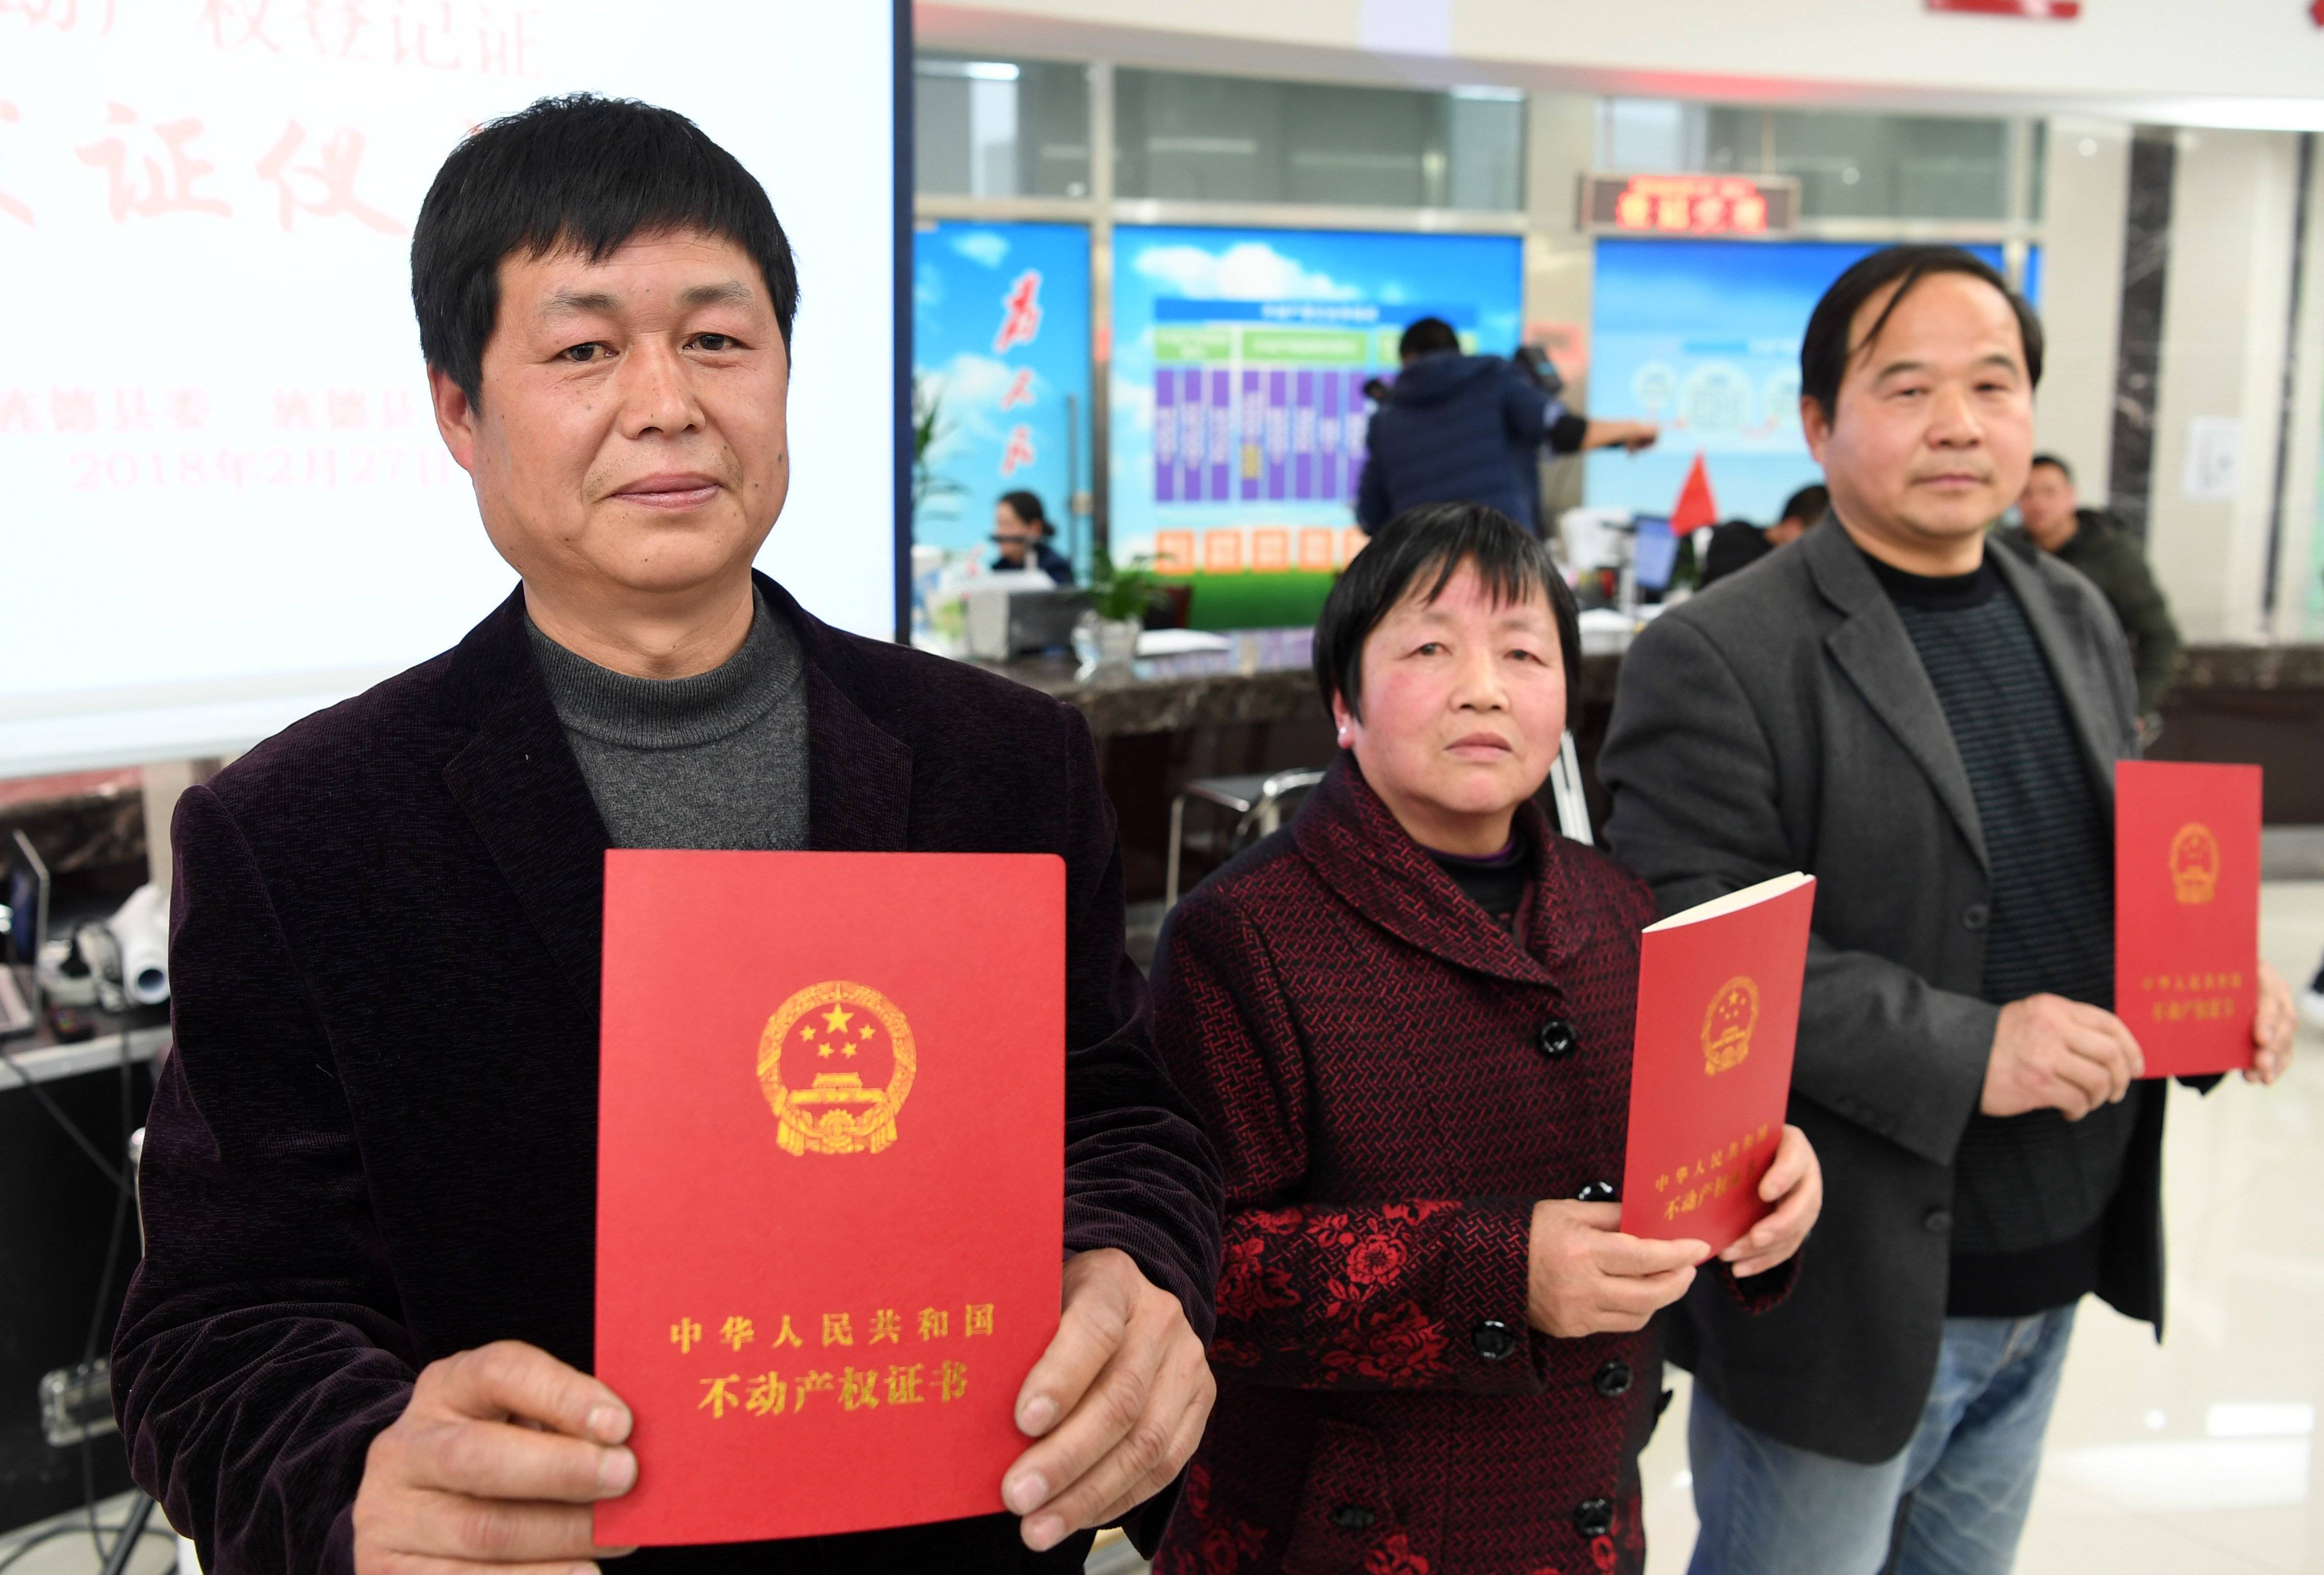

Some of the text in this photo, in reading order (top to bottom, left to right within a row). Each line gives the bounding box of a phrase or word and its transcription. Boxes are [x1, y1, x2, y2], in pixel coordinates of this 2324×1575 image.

[0, 100, 482, 233] 证仪
[670, 1302, 995, 1355] 中华人民共和国
[698, 1359, 968, 1420] 不动产权证书
